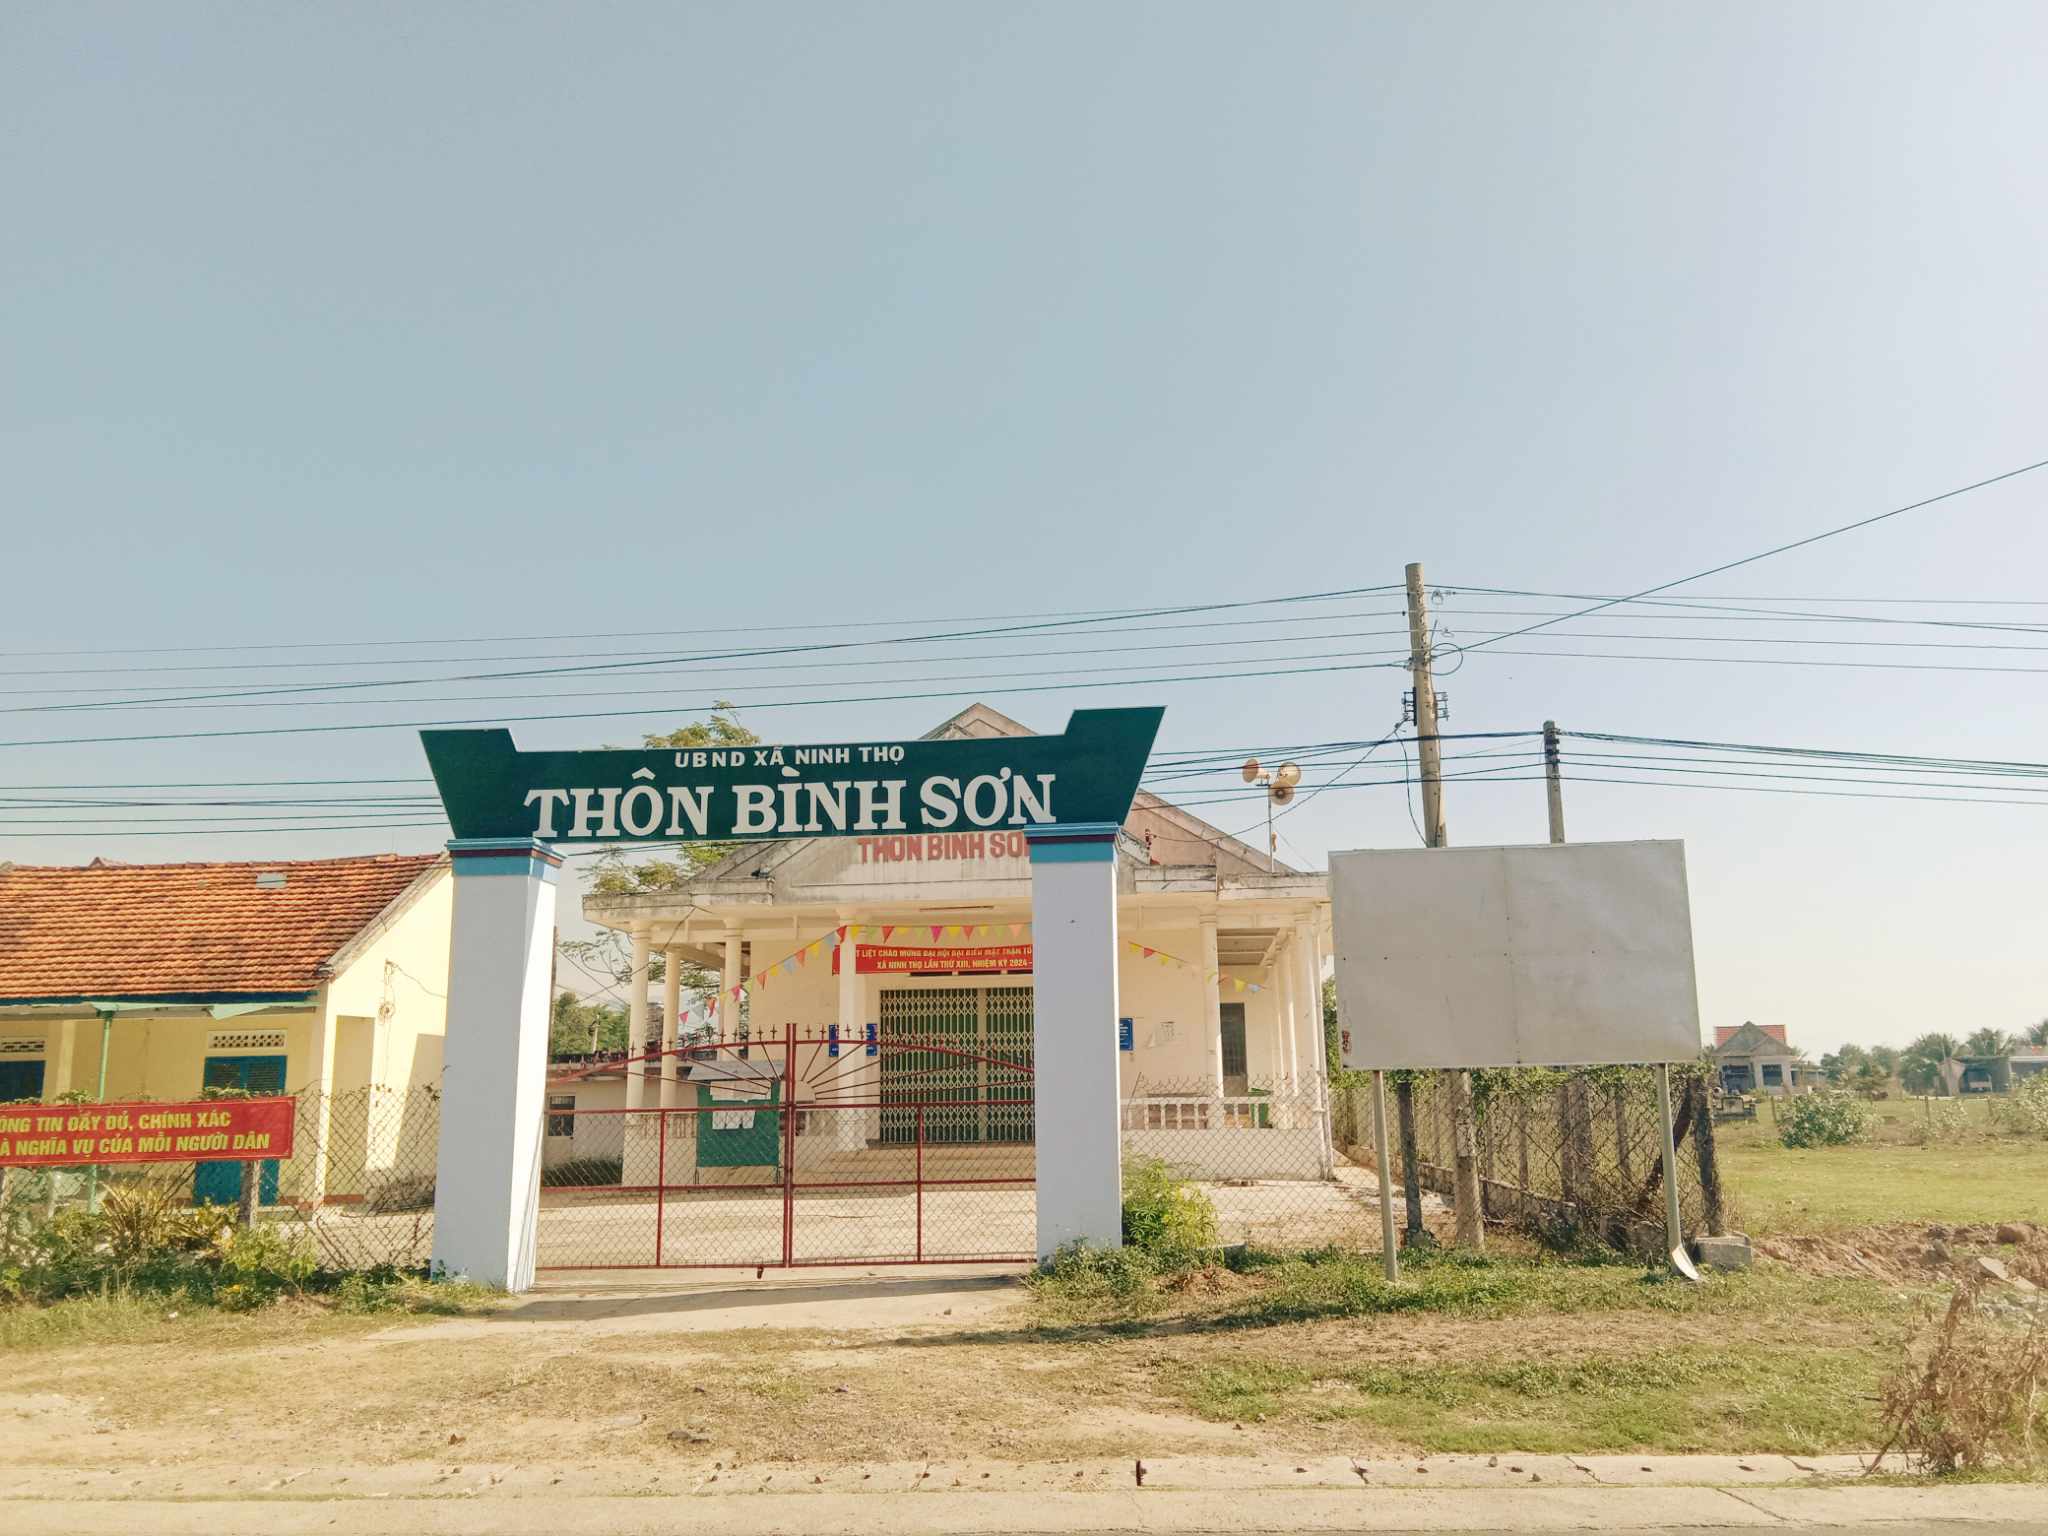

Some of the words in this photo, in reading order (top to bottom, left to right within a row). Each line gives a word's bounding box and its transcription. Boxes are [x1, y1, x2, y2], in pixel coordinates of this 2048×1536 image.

[675, 750, 745, 768] UBND
[754, 746, 785, 767] XÃ
[795, 747, 850, 765] NINH
[858, 746, 905, 766] THỌ
[523, 767, 715, 838] THÔN
[731, 766, 907, 835] BÌNH
[920, 766, 1057, 828] SƠN
[37, 1116, 64, 1132] TIN
[105, 1110, 133, 1132] ĐỦ,
[138, 1111, 192, 1130] CHÍNH
[196, 1108, 231, 1128] XÁC
[15, 1137, 67, 1156] NGHĨA
[73, 1139, 95, 1158] VỤ
[99, 1133, 133, 1154] CỦA
[175, 1131, 229, 1152] NGƯỜI
[232, 1130, 270, 1150] DÂN
